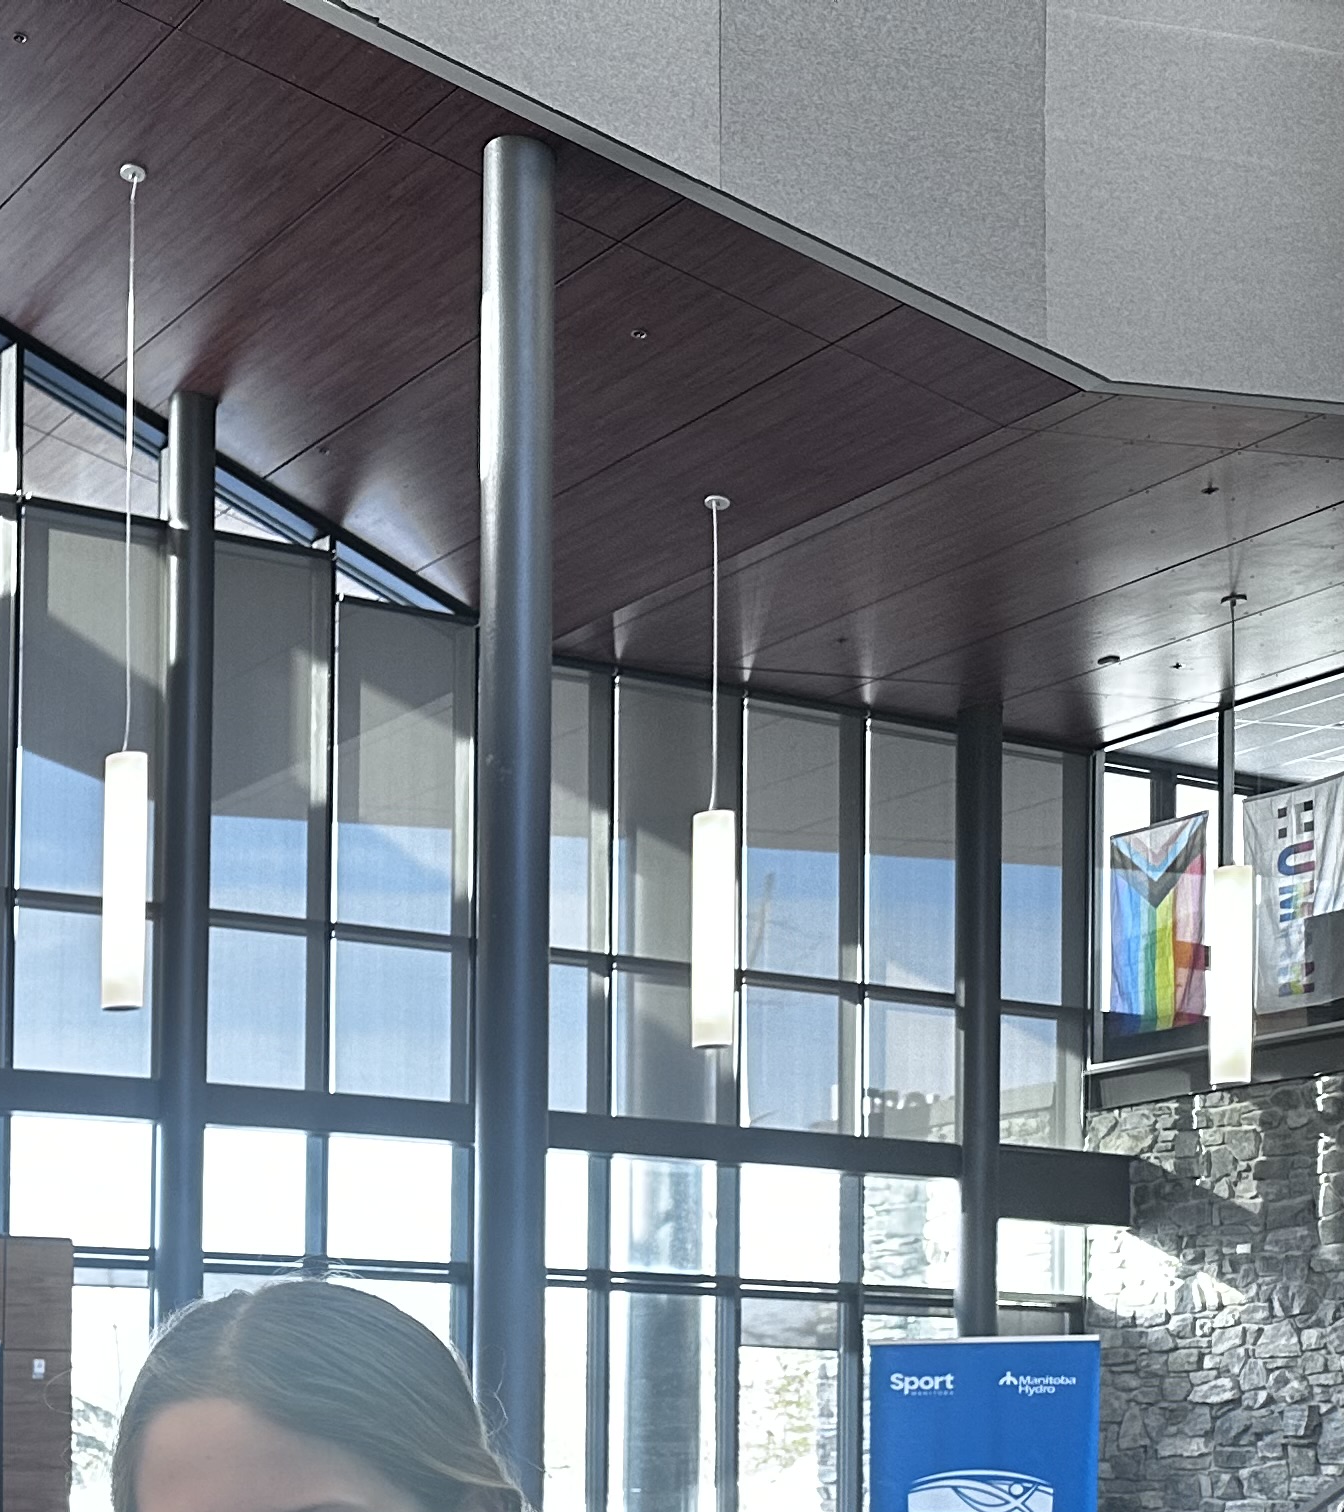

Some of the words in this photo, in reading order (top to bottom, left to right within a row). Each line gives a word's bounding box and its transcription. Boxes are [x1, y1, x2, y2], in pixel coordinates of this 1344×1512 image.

[1277, 799, 1315, 998] HUMN
[889, 1373, 954, 1396] Sport
[1018, 1375, 1077, 1386] Manitoba
[1018, 1385, 1056, 1397] Hydro
